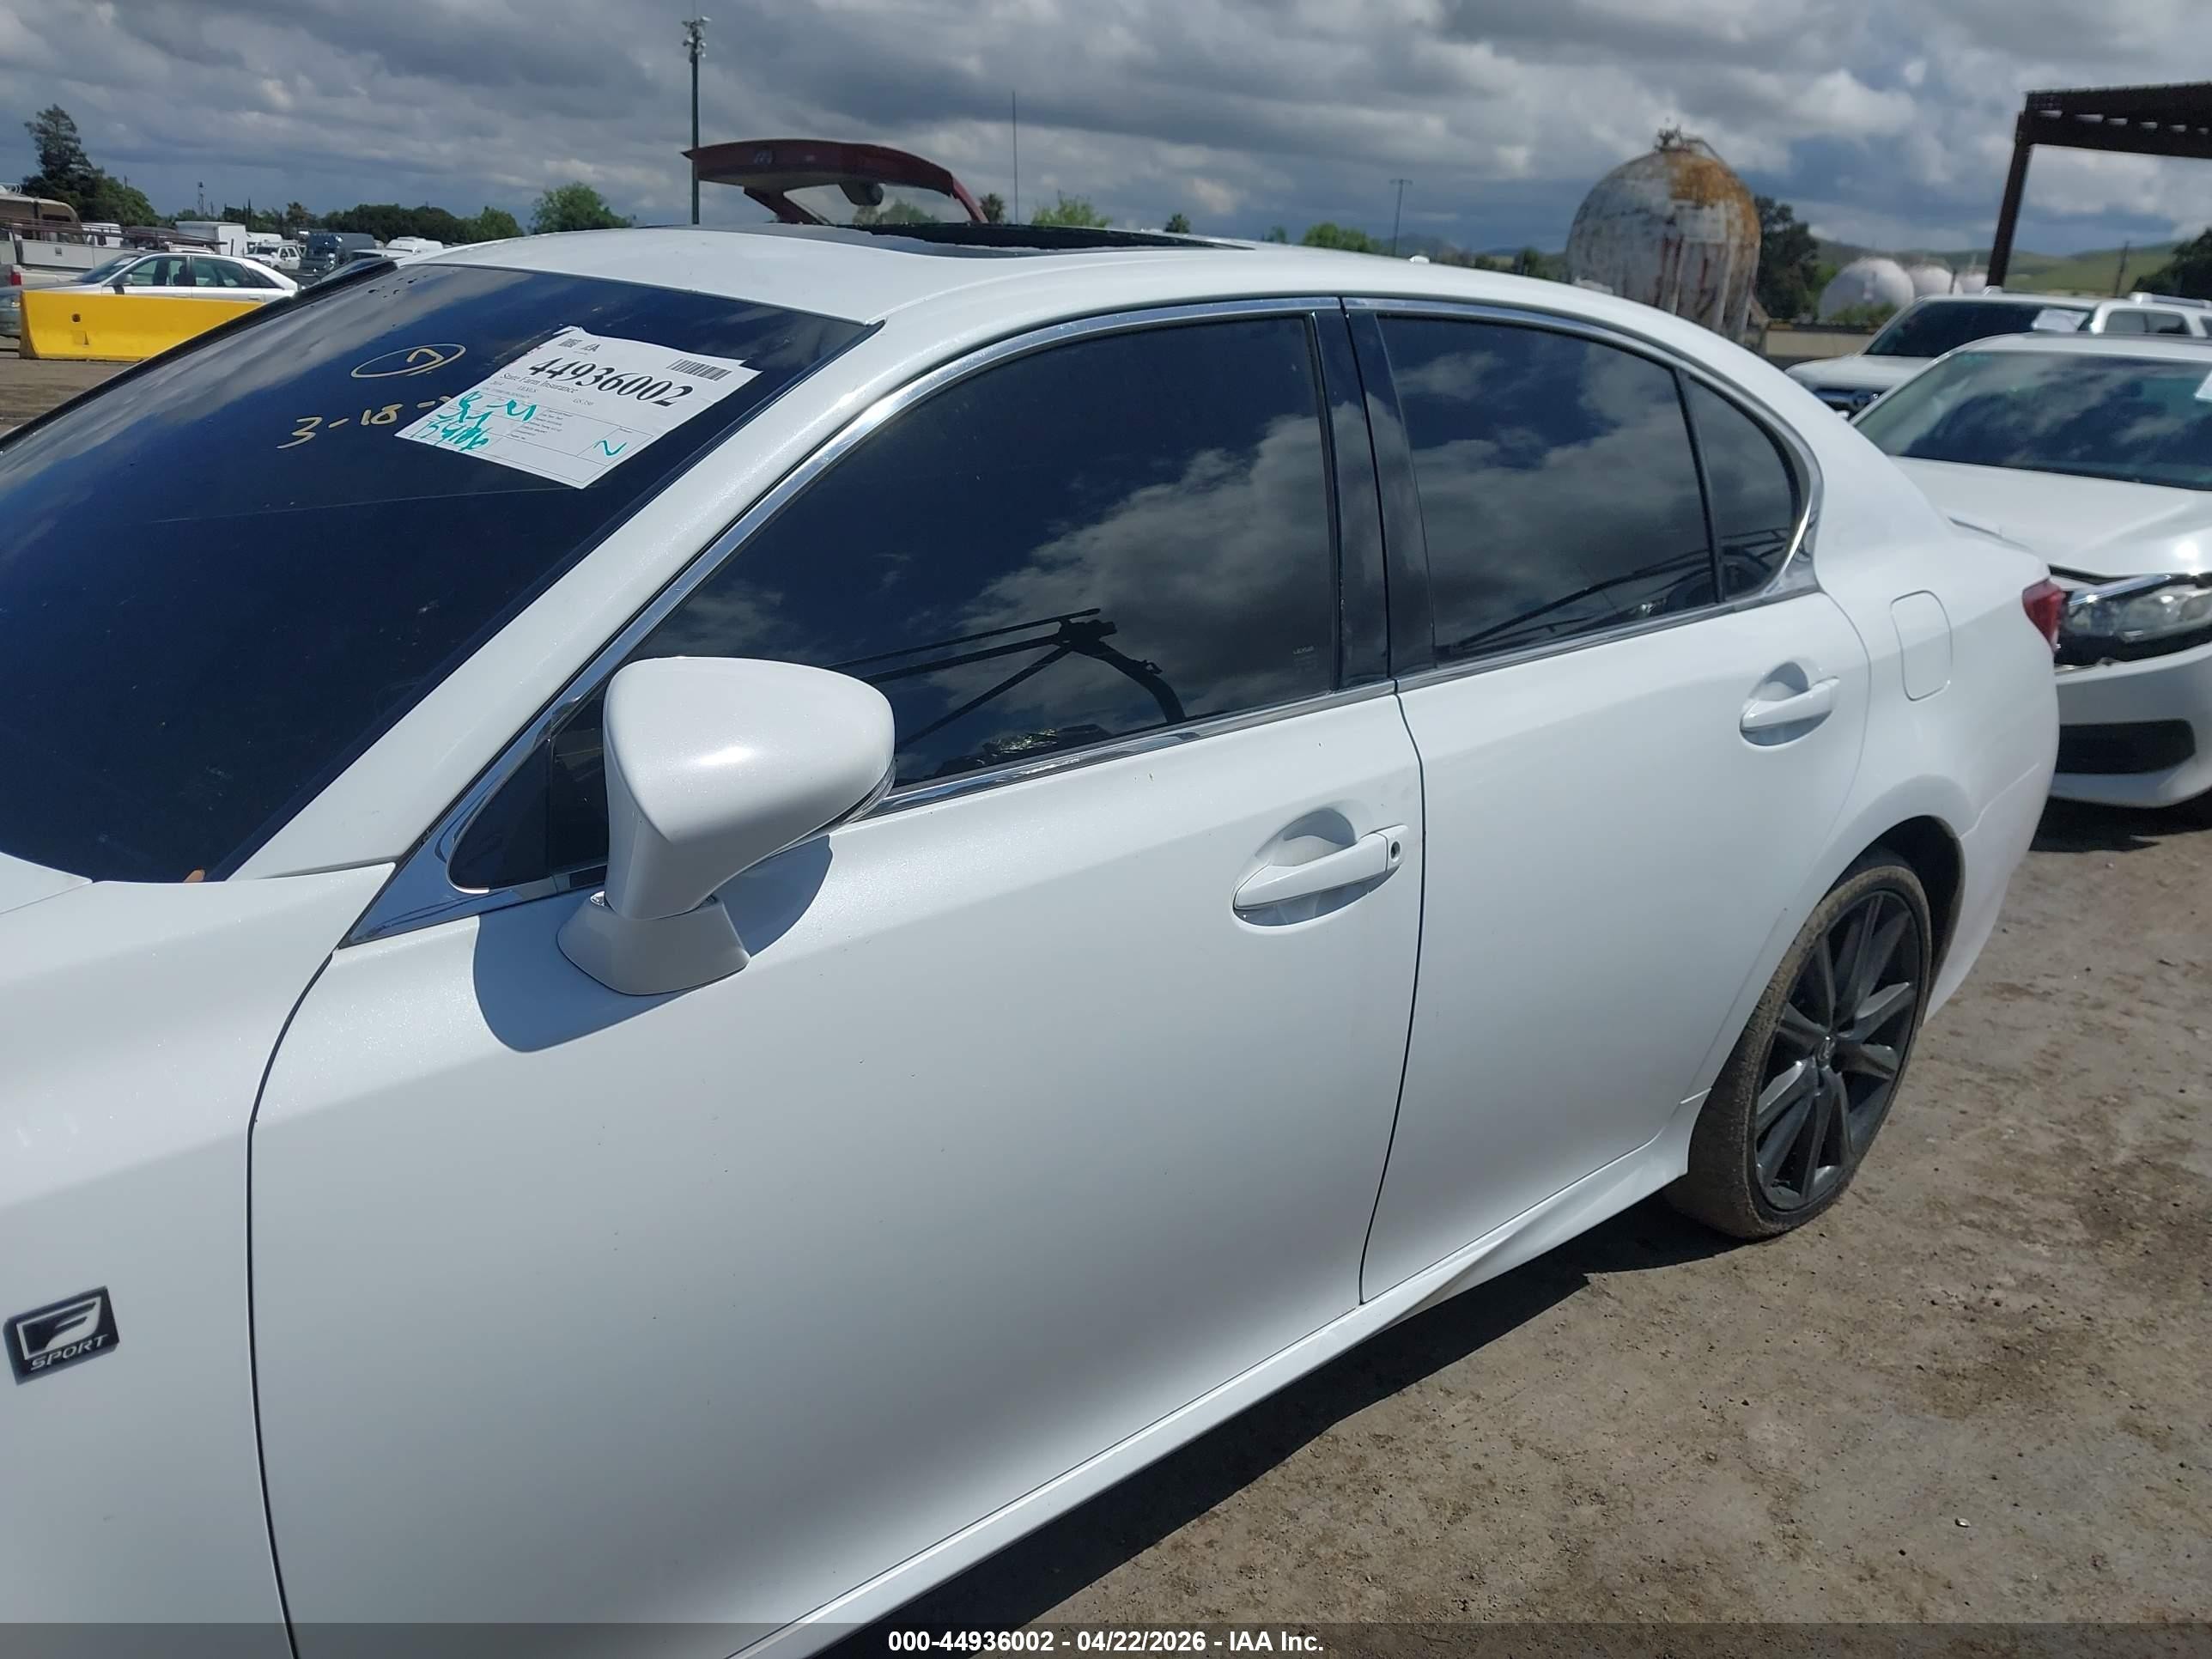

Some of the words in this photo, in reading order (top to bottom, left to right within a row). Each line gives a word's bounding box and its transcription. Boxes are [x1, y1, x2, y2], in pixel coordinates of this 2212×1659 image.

[500, 373, 520, 381] State
[519, 377, 538, 386] Farm
[540, 380, 580, 393] Insurance
[529, 357, 694, 406] 44936002
[30, 1334, 108, 1370] SPORT
